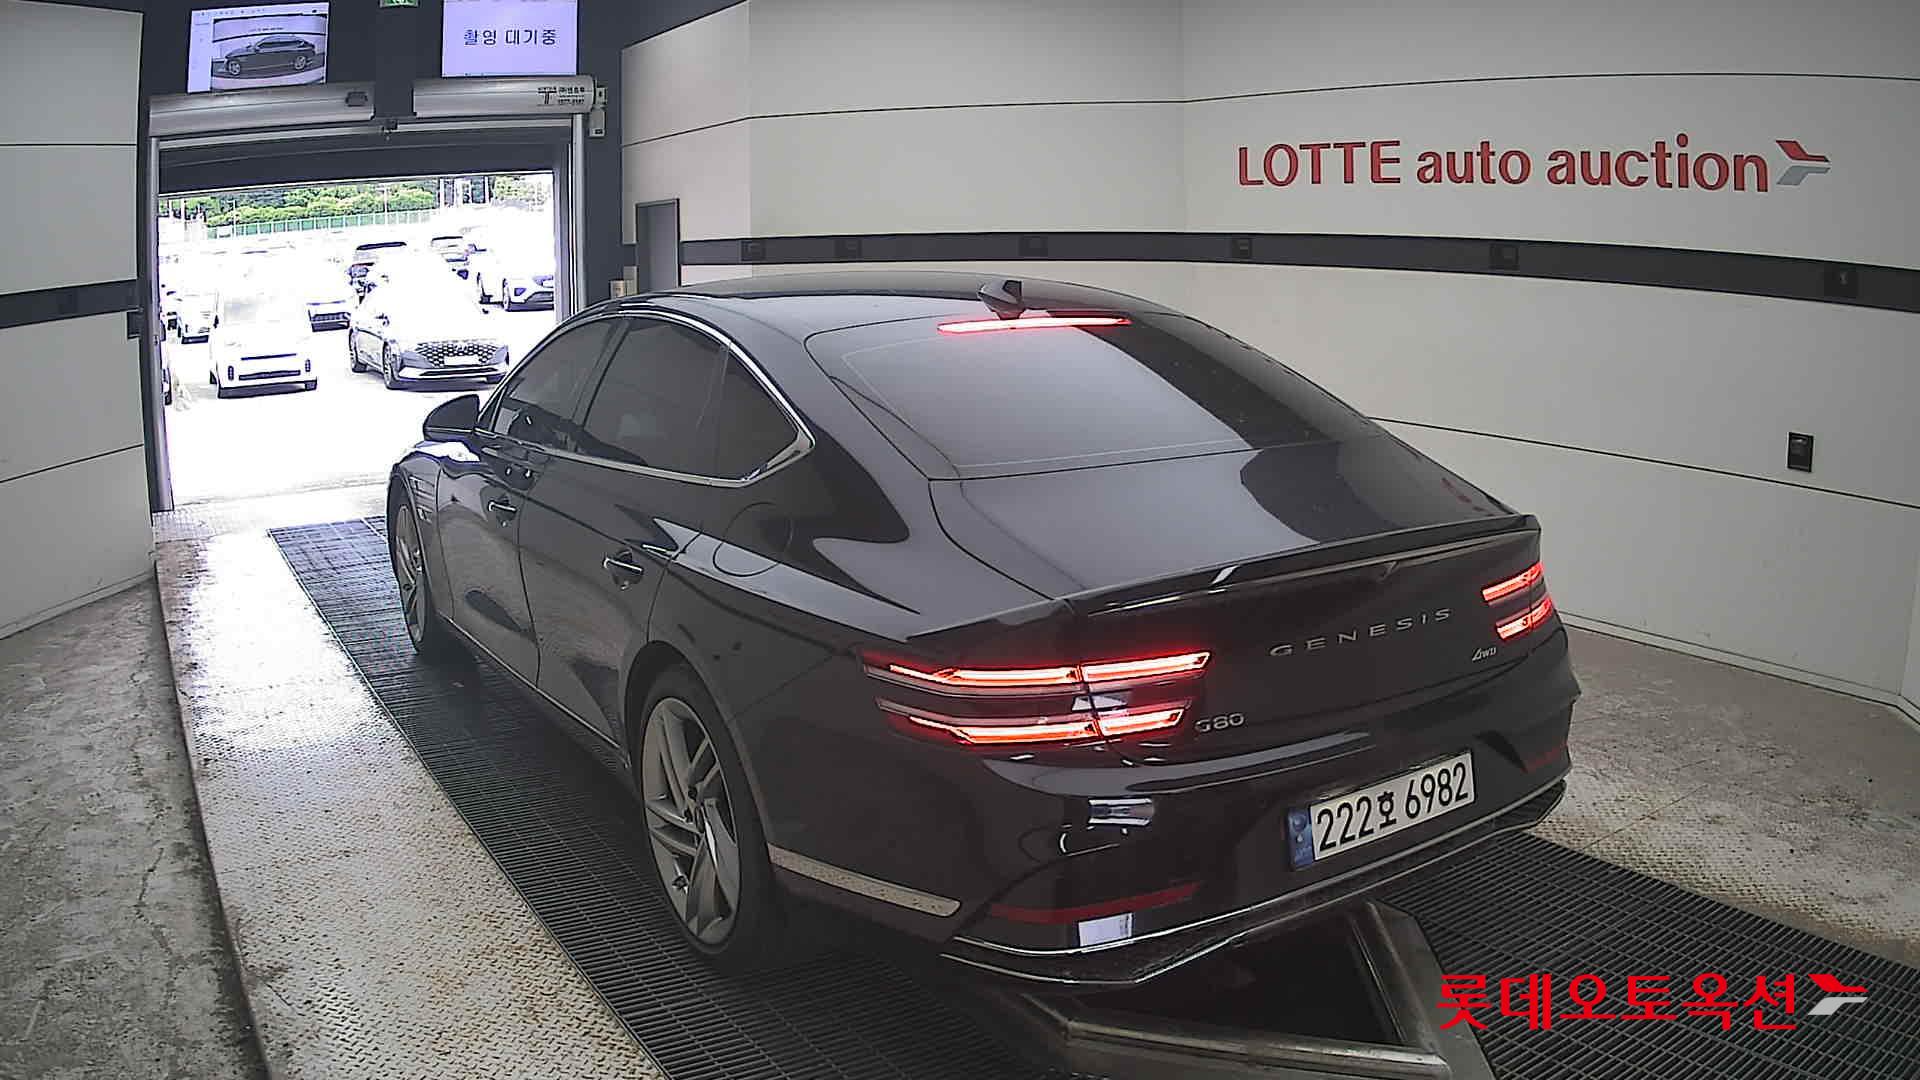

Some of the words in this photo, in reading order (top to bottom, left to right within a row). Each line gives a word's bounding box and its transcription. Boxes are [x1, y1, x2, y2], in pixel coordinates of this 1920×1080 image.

[505, 29, 556, 46] 대기중
[1239, 140, 1400, 187] LOTTE
[1418, 142, 1532, 184] auto
[1547, 135, 1769, 191] auction
[1270, 608, 1451, 656] GENESIS
[1195, 713, 1245, 732] G80
[1317, 791, 1397, 852] 222호
[1405, 762, 1469, 819] 6982
